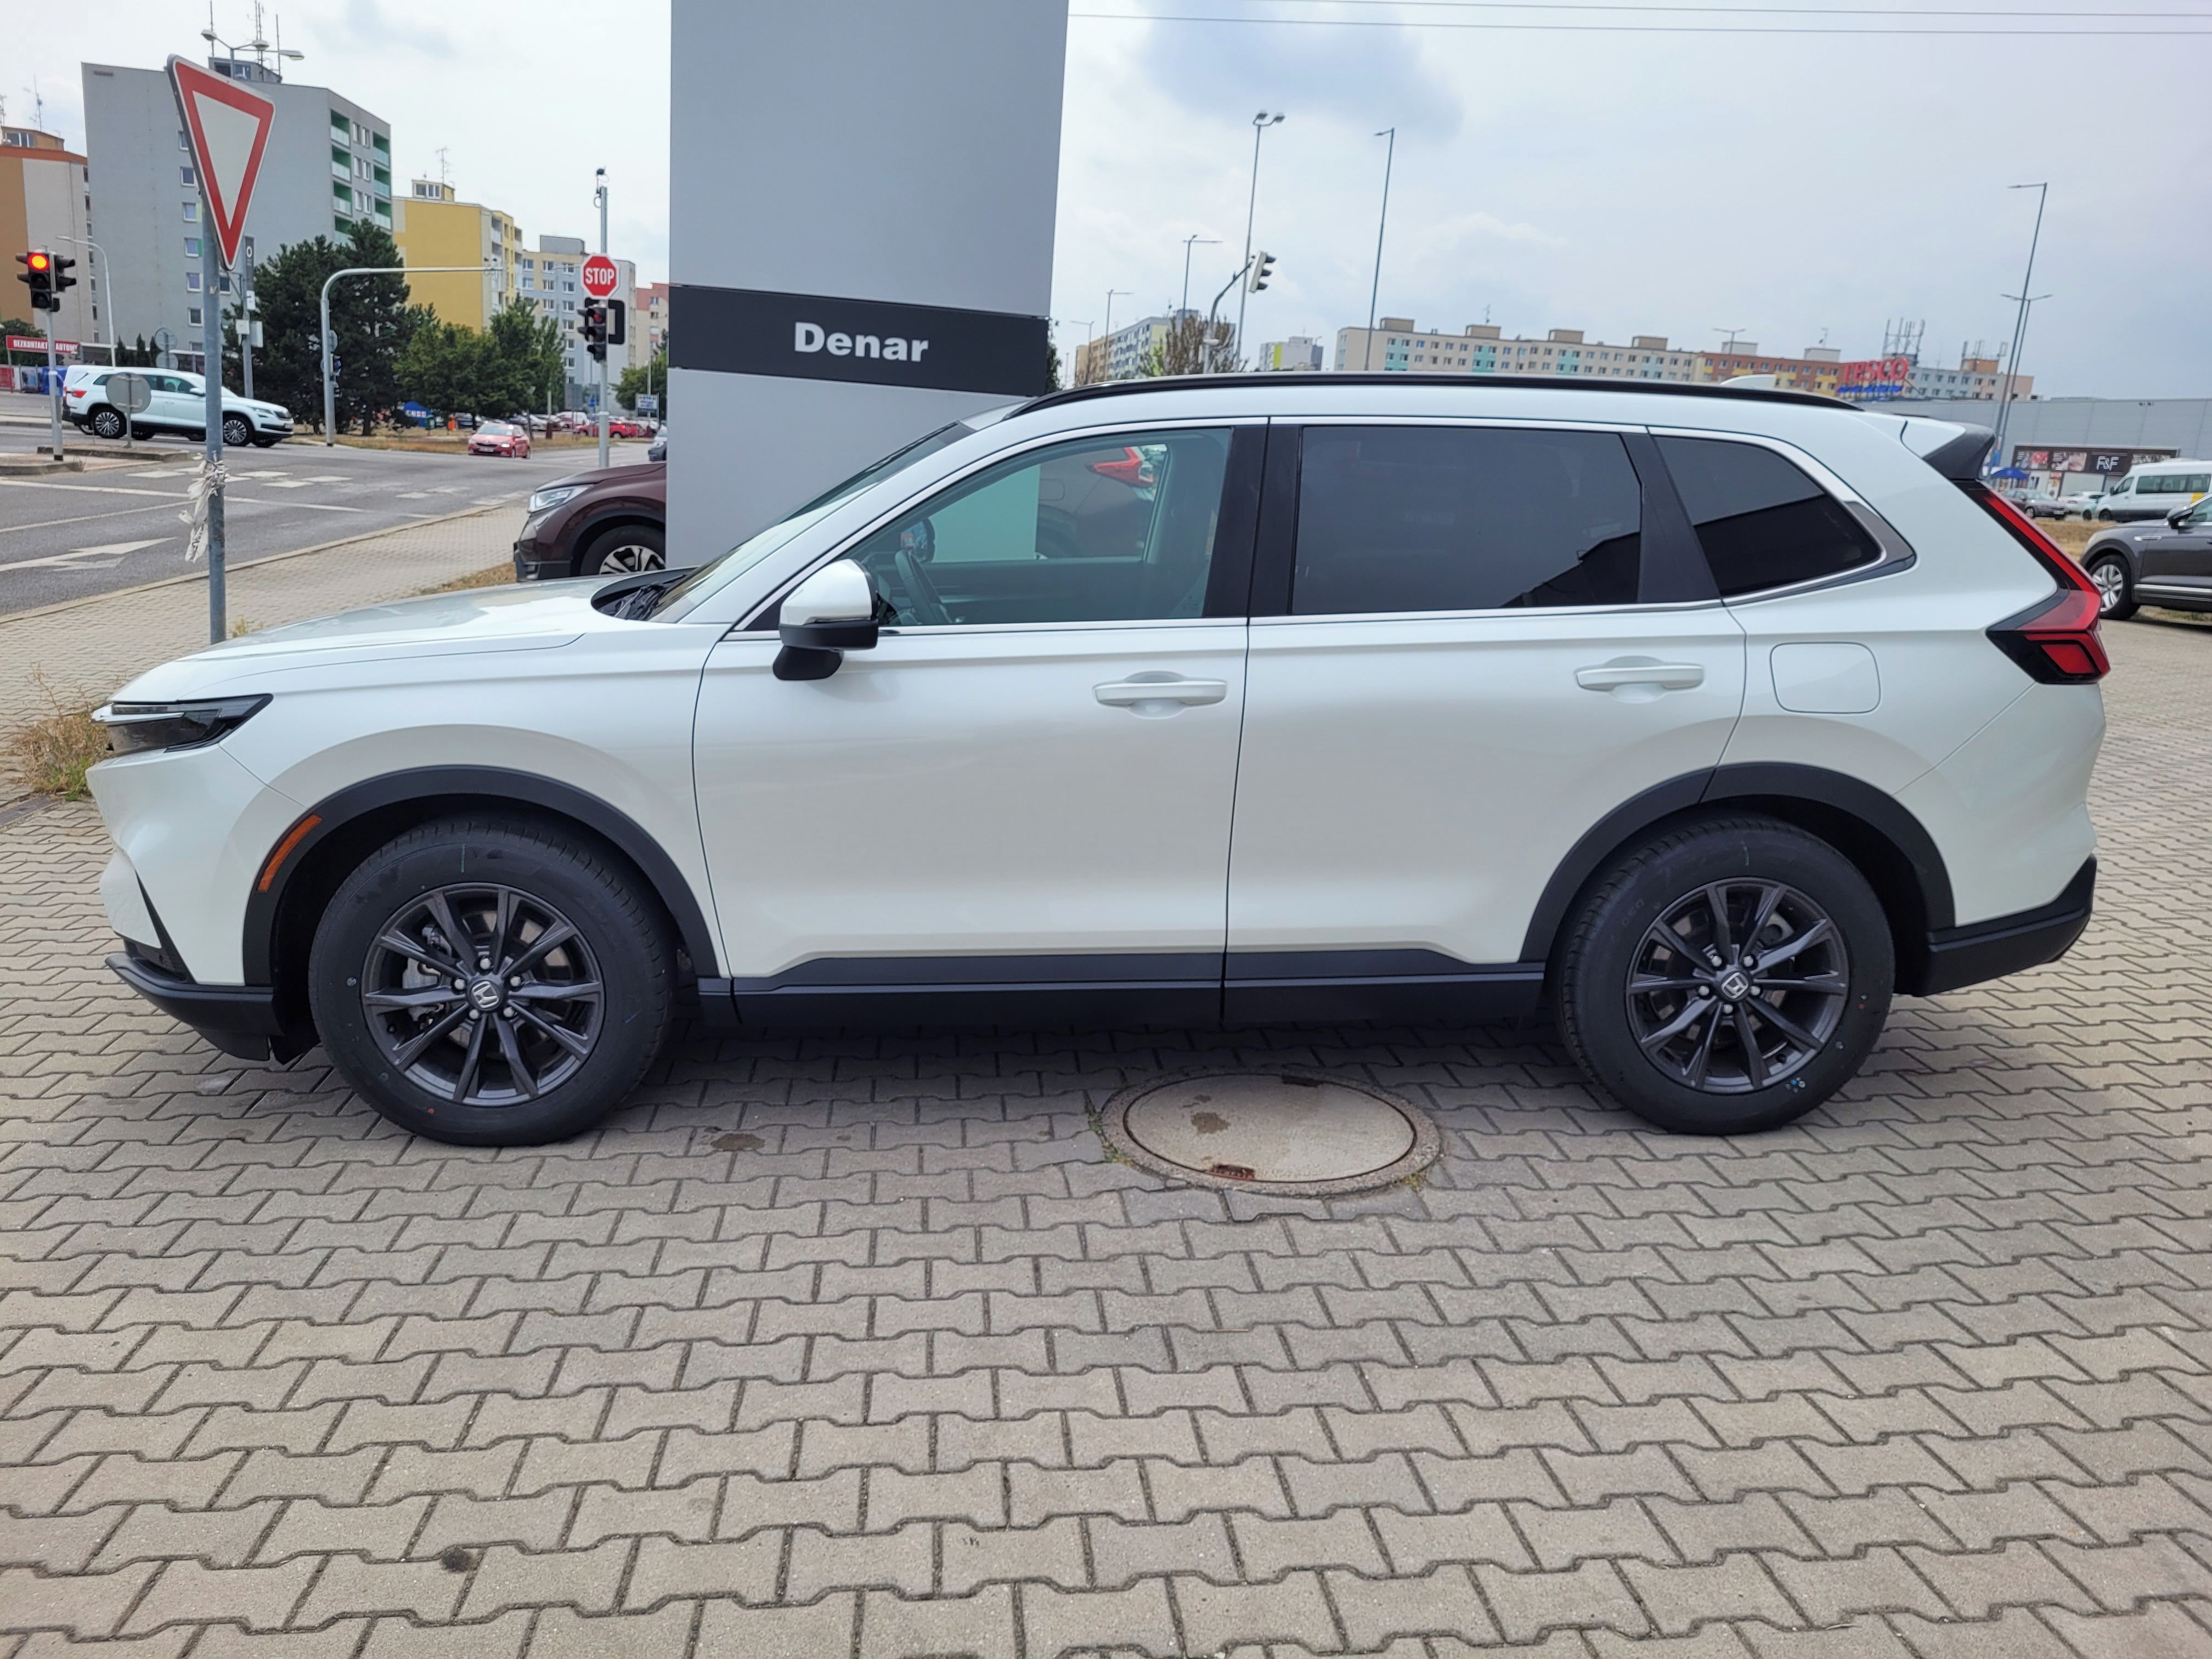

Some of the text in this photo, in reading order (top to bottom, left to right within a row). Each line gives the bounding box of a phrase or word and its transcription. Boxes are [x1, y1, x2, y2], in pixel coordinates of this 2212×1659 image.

[585, 267, 614, 285] STOP
[794, 321, 929, 362] Denar
[1841, 358, 1909, 382] TESCO
[2096, 455, 2120, 471] F&F
